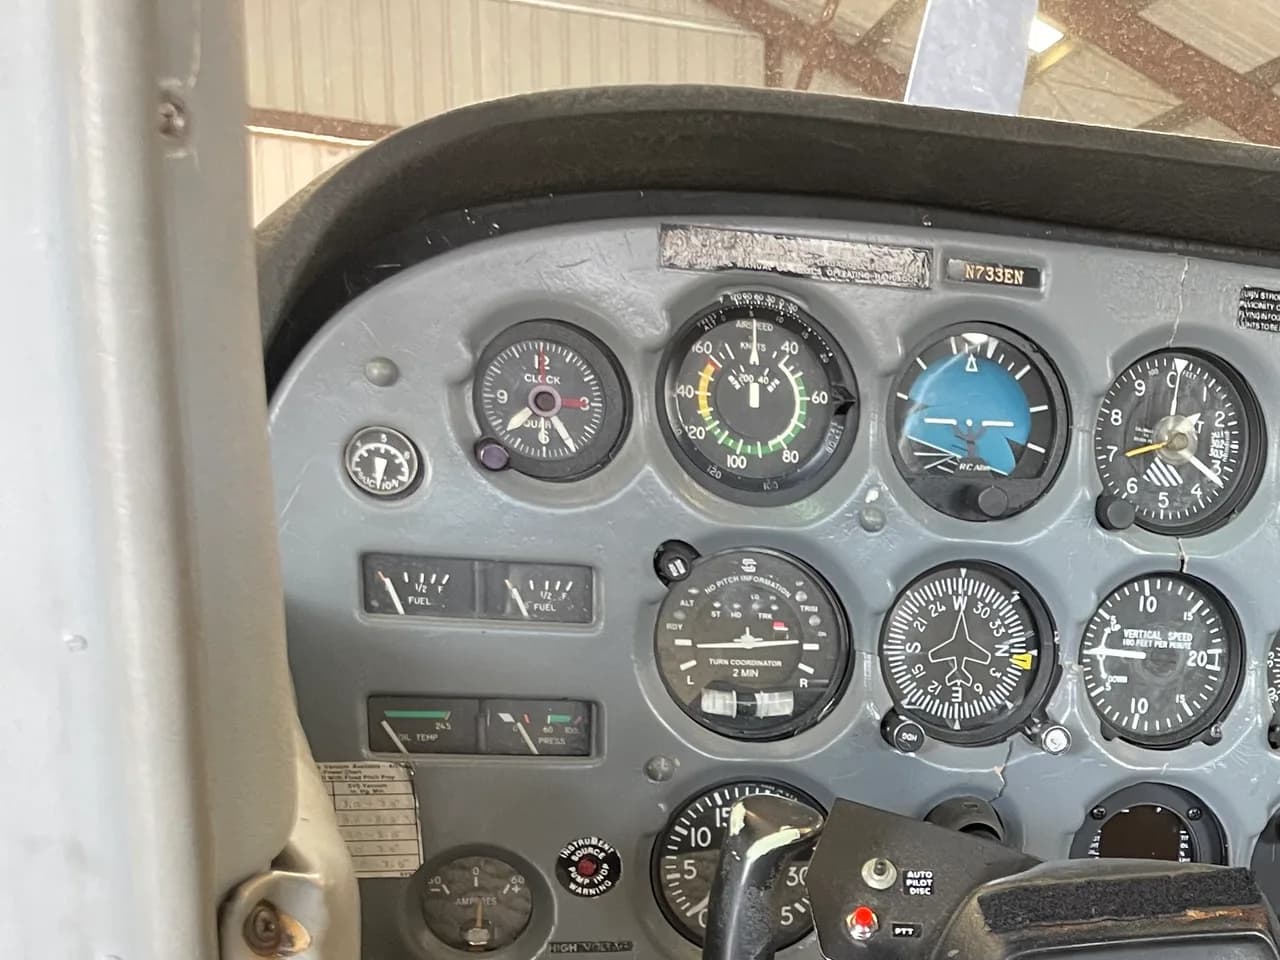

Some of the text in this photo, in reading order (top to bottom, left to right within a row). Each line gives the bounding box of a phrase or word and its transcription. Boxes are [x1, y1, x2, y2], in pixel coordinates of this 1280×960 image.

[964, 264, 1024, 285] N733EN
[692, 342, 713, 355] 160
[780, 341, 799, 355] 40
[534, 354, 550, 370] 12
[1134, 380, 1146, 396] 9
[496, 390, 508, 404] 9
[579, 396, 590, 411] 3
[811, 392, 828, 404] 60
[1110, 409, 1122, 426] 8
[1214, 410, 1226, 427] 2
[538, 430, 550, 444] 6
[782, 450, 799, 464] 80
[1107, 445, 1118, 462] 7
[727, 455, 747, 469] 100
[1211, 459, 1222, 476] 3
[1126, 477, 1138, 494] 6
[1190, 483, 1202, 498] 4
[1158, 492, 1170, 508] 5
[704, 576, 792, 599] NO PITCH INFORMATION
[408, 596, 431, 606] FUEL
[534, 603, 557, 612] FUEL
[952, 596, 968, 611] W
[1139, 596, 1157, 613] 10
[928, 602, 947, 618] 24
[973, 603, 991, 620] 30
[1183, 612, 1194, 621] 15
[912, 617, 928, 633] 21
[989, 620, 1006, 637] 33
[1123, 628, 1193, 642] VERTICAL SPEED
[905, 641, 922, 654] S
[994, 644, 1010, 657] N
[1136, 640, 1152, 648] FEET
[1168, 642, 1192, 650] MINUTE
[708, 658, 782, 668] TURN COORDINATOR
[1187, 650, 1208, 667] 20
[732, 669, 759, 678] 2 MIN
[911, 663, 927, 679] 15
[989, 666, 1002, 679] 3
[687, 675, 695, 685] L
[799, 678, 809, 688] R
[927, 680, 942, 696] 12
[951, 686, 963, 703] E
[973, 682, 984, 695] 6
[1131, 697, 1149, 714] 10
[1175, 694, 1186, 703] 15
[416, 733, 439, 742] TEMP
[538, 737, 566, 745] PRESS
[690, 826, 712, 847] 10
[560, 836, 616, 859] INSTRUMENT
[571, 847, 606, 863] SOURCE
[472, 866, 480, 876] 0
[567, 863, 609, 885] PUMP INOP
[683, 860, 697, 879] 5
[786, 866, 808, 887] 30
[907, 870, 933, 879] AUTO
[568, 879, 613, 897] WARNING
[906, 879, 933, 887] PILOT
[909, 887, 932, 895] DISC
[894, 927, 914, 935] PTT
